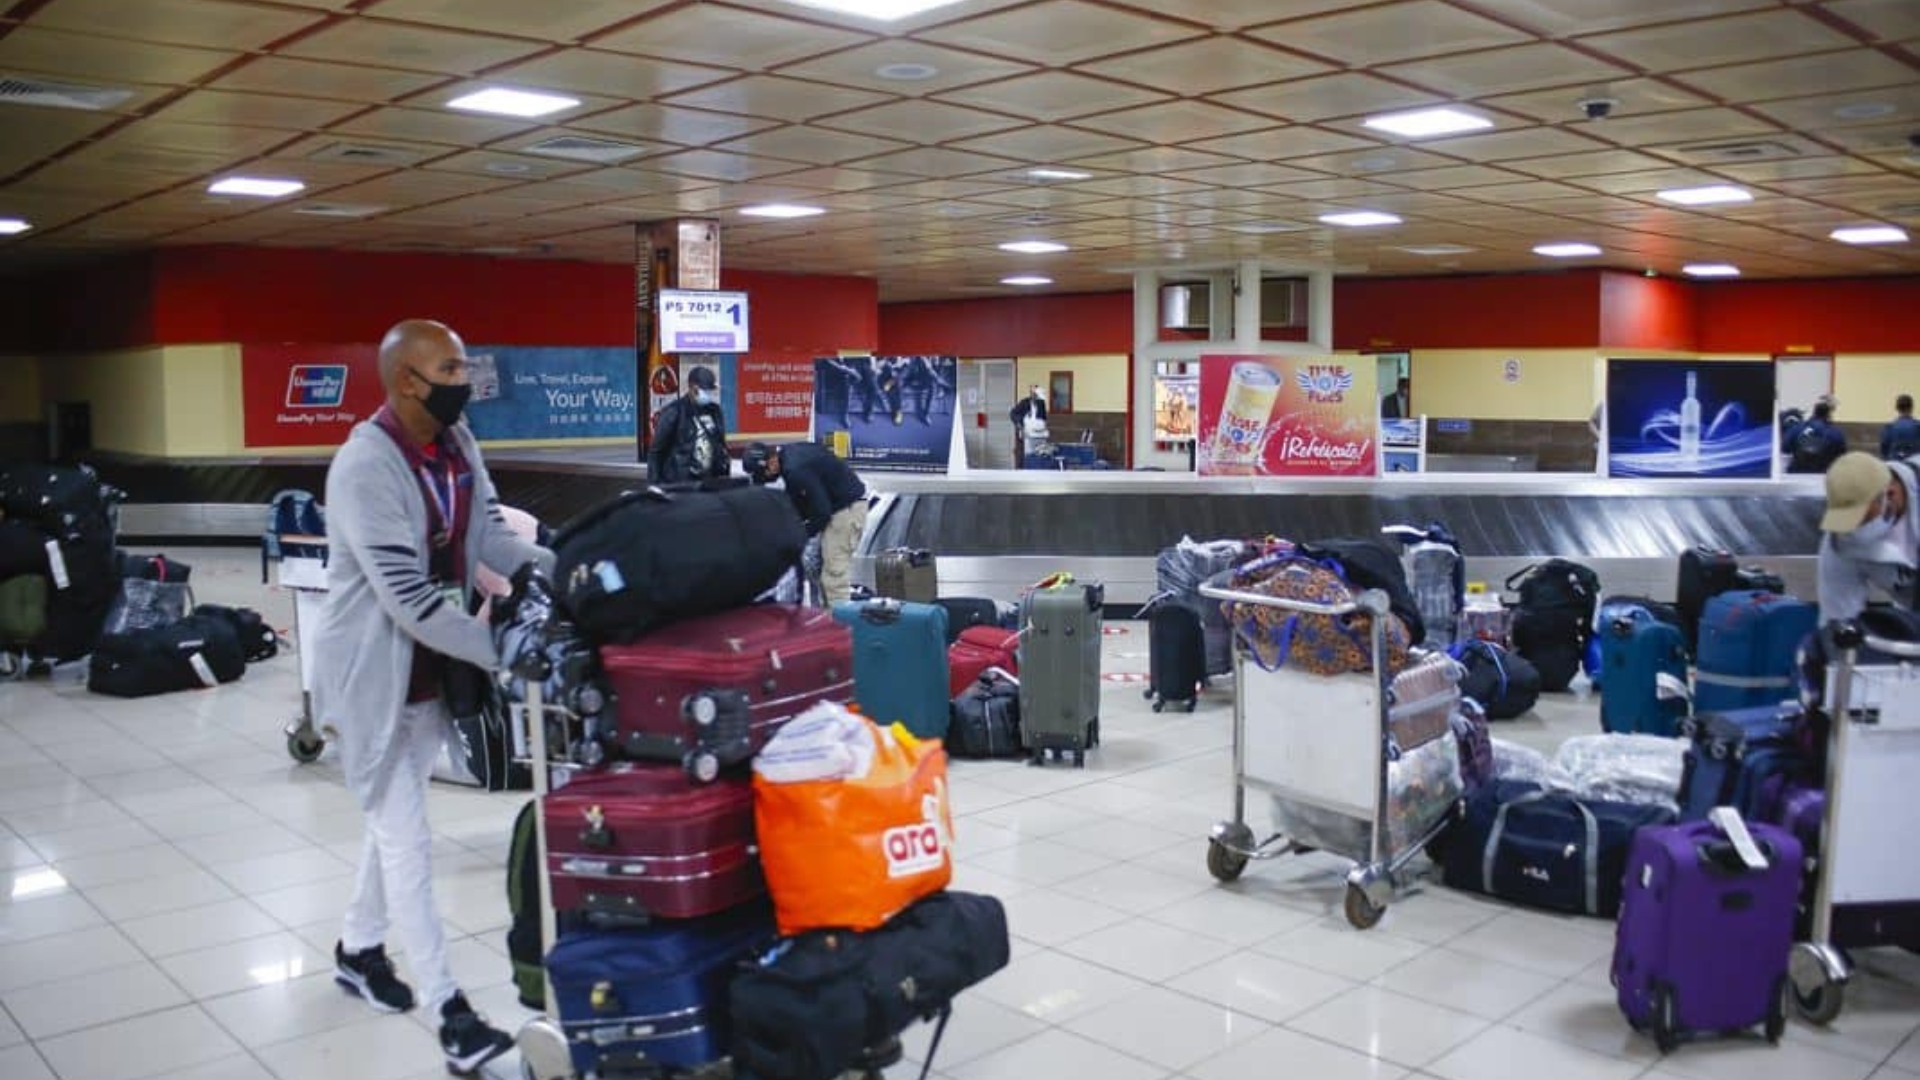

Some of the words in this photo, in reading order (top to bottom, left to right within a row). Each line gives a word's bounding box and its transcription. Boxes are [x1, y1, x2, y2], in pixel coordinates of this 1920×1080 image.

[688, 302, 722, 314] 7012
[725, 303, 741, 327] 1
[545, 389, 589, 408] Your
[591, 389, 634, 412] Way.
